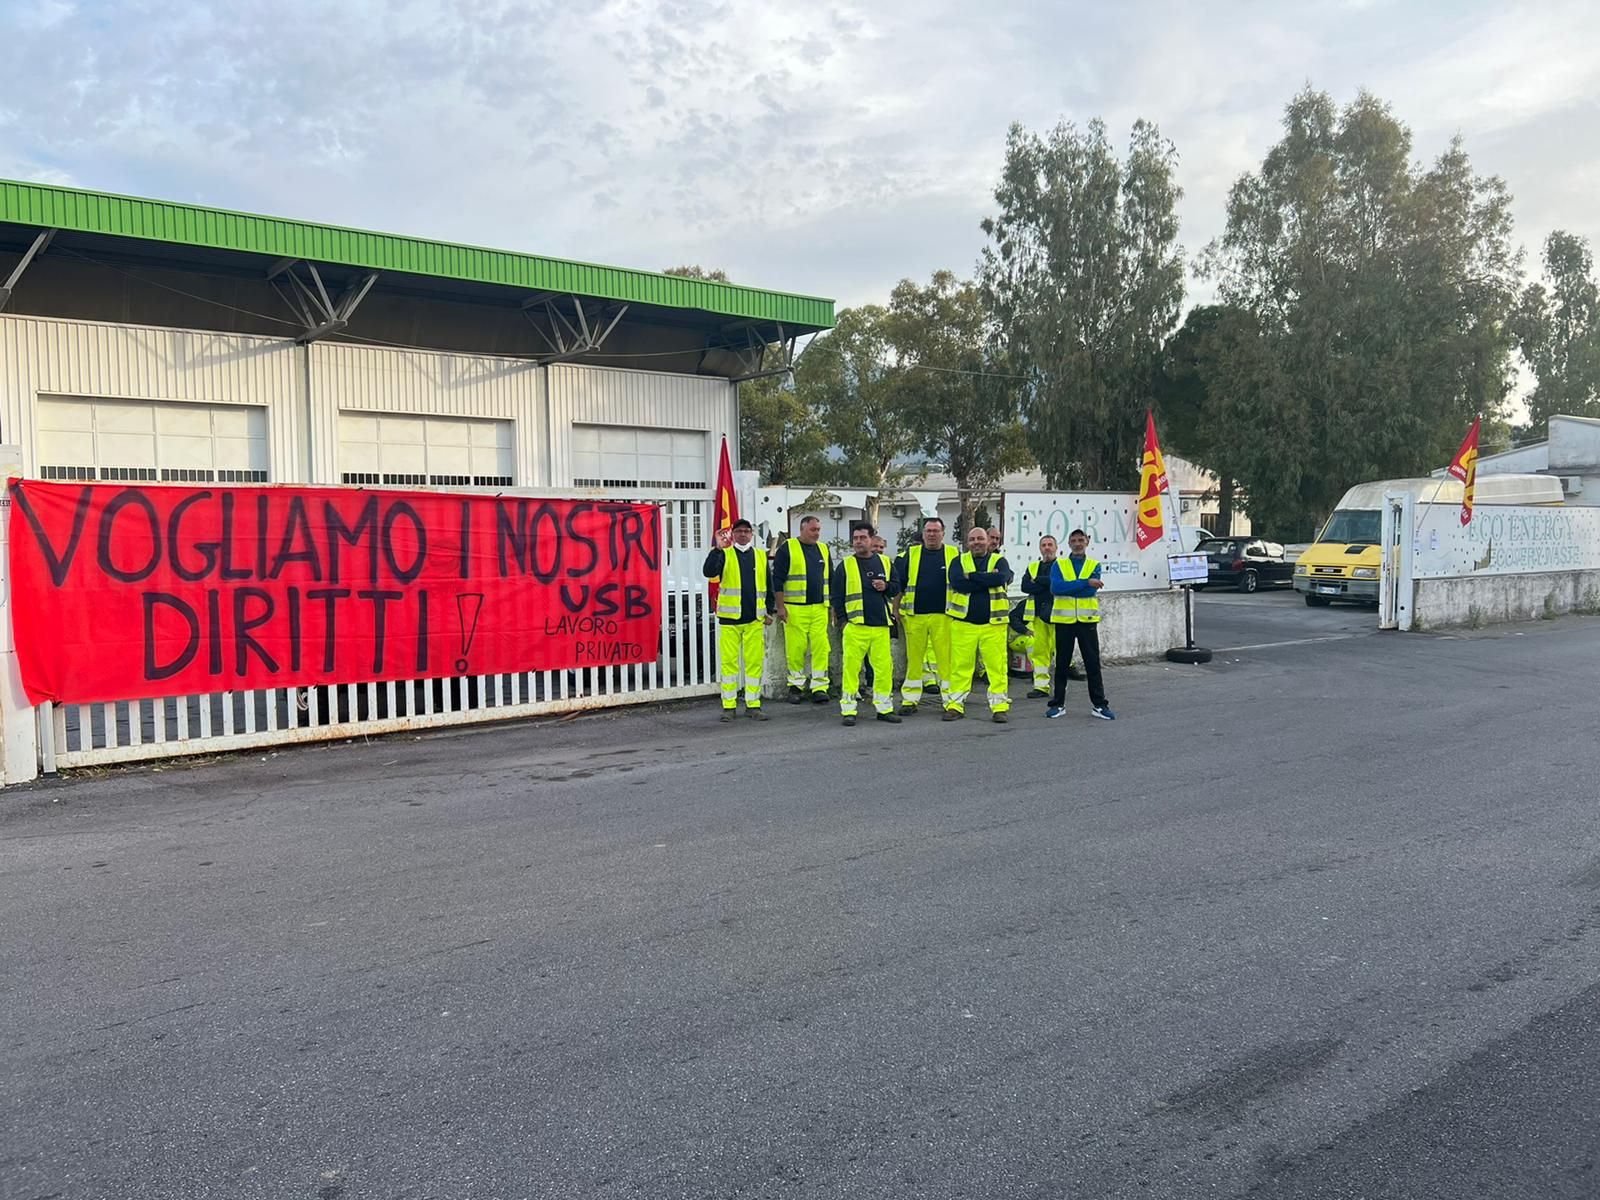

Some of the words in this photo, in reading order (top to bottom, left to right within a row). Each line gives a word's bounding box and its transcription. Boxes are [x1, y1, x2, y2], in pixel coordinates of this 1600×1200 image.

[9, 484, 428, 587] VOGLIAMO
[459, 500, 471, 579] I
[498, 497, 660, 586] NOSTRI
[1013, 508, 1167, 546] FORM
[1468, 513, 1504, 541] ECO
[1508, 513, 1574, 541] ENERGY
[559, 582, 653, 620] USB
[141, 588, 428, 682] DIRITTI
[544, 614, 619, 637] LAVORO
[574, 639, 643, 664] PRIVATO
